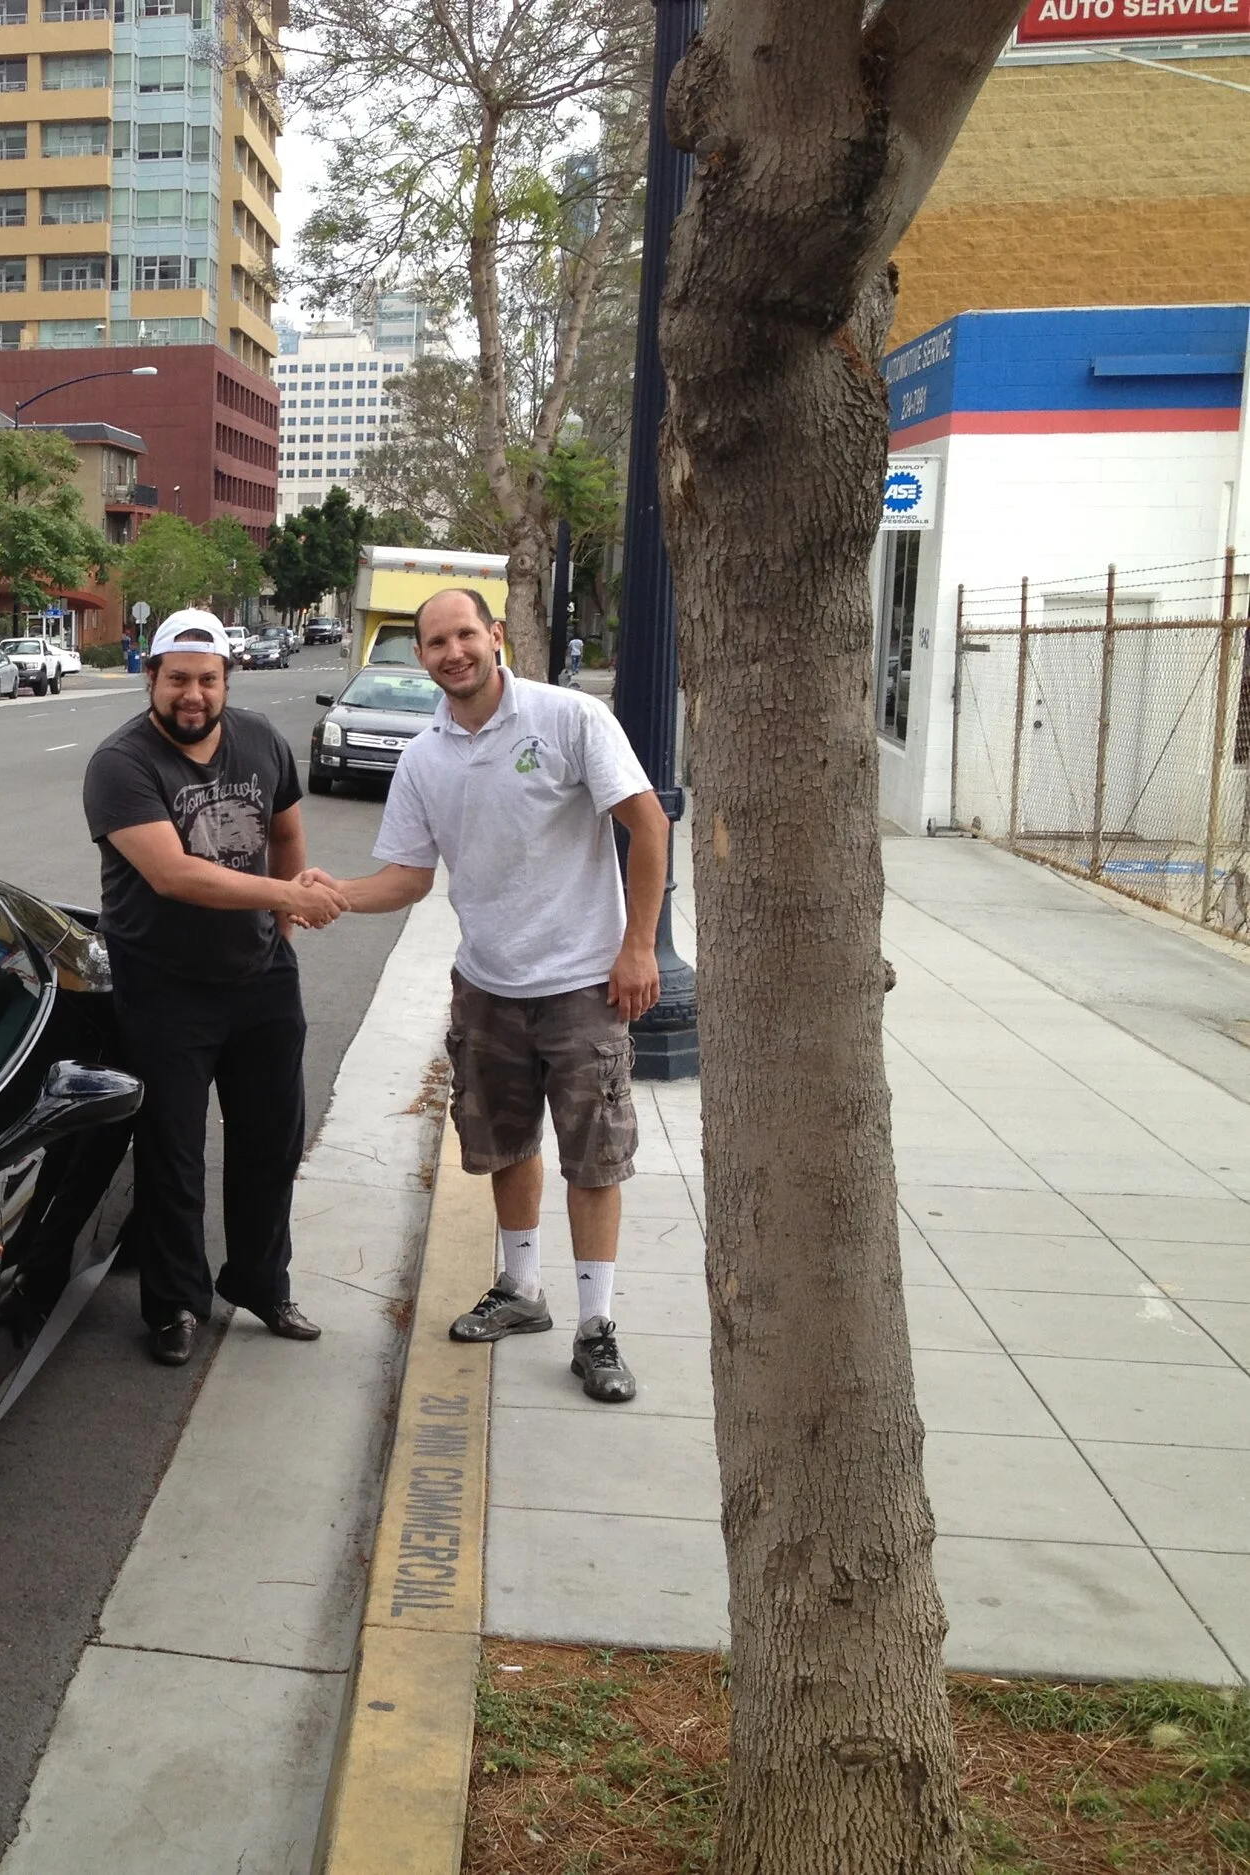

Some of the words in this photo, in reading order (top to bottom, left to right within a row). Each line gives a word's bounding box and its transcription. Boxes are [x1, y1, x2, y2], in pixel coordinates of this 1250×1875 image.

[1038, 0, 1114, 21] AUTO
[1123, 0, 1239, 17] SERVICE
[922, 327, 952, 369] SERVICE
[884, 484, 918, 500] ASE
[173, 772, 265, 822] Tomahawk
[419, 1394, 470, 1417] 20
[412, 1424, 469, 1458] MIN
[391, 1466, 464, 1618] COMMERCIAL
